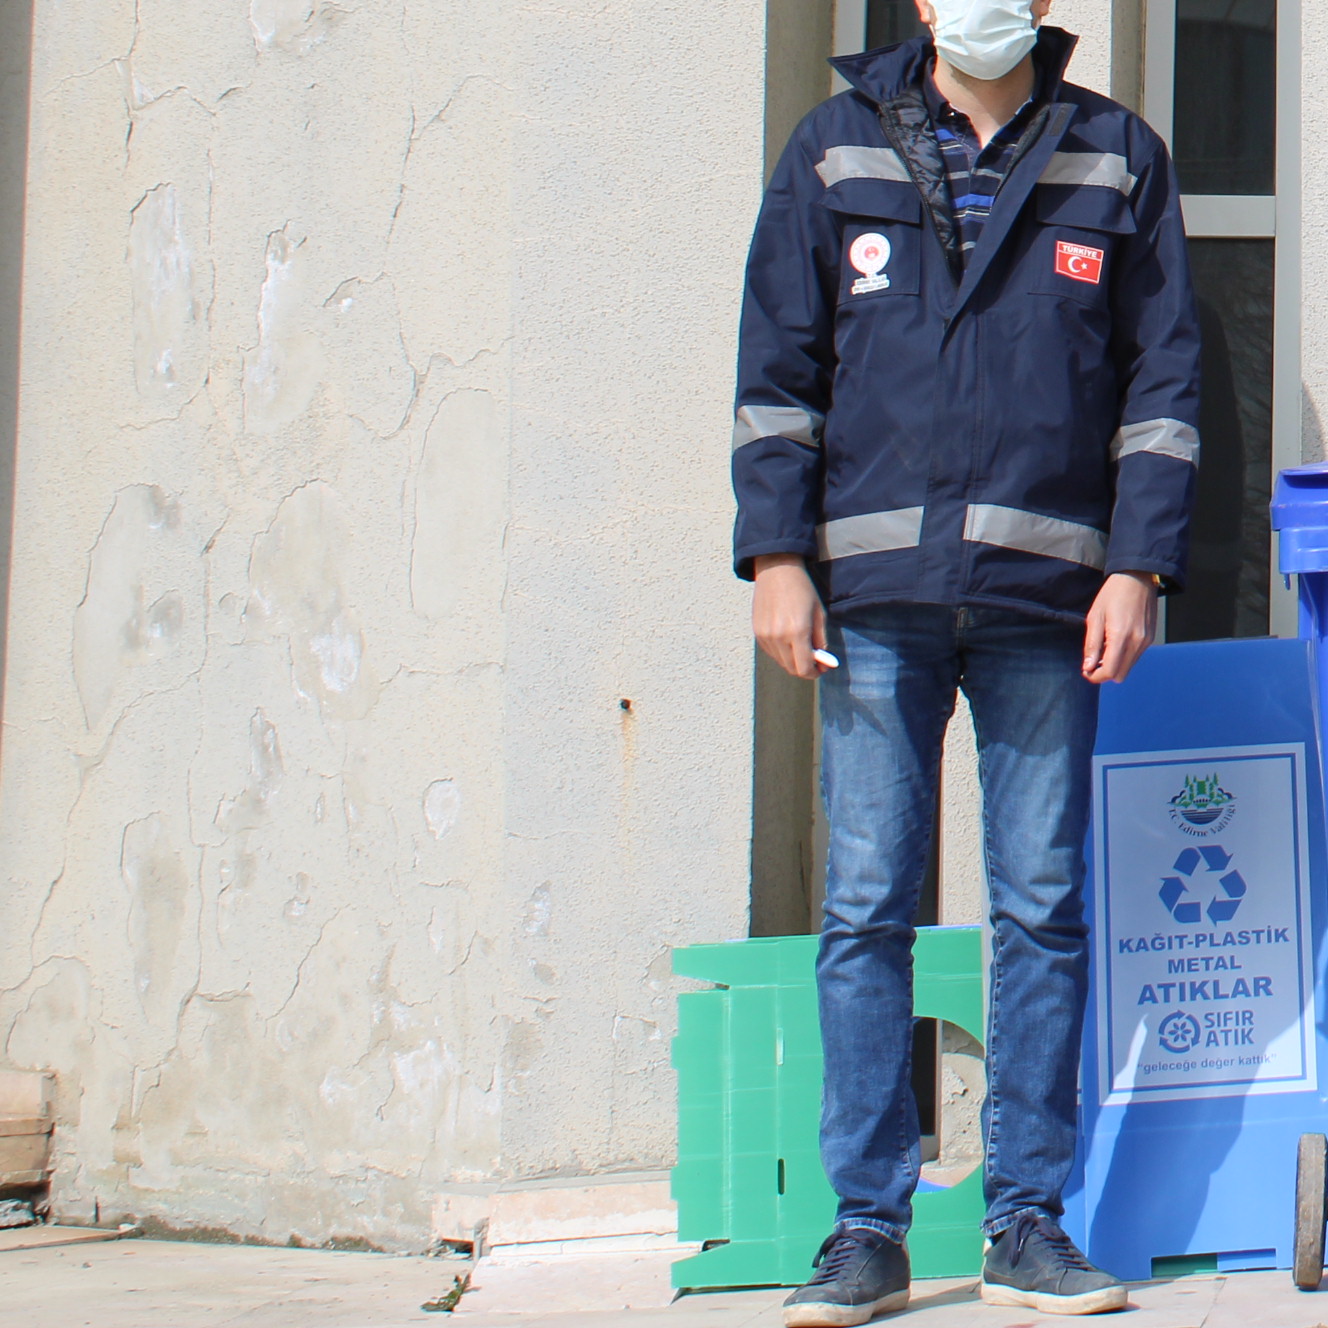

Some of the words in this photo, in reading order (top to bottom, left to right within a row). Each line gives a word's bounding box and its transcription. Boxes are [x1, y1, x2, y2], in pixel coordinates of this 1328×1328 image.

[1118, 925, 1289, 953] KAĞIT-PLASTİK
[1168, 955, 1242, 974] METAL
[1137, 976, 1273, 1006] ATIKLAR
[1204, 1009, 1254, 1028] SIFIR
[1205, 1027, 1254, 1048] ATIK
[1201, 1057, 1234, 1069] değer
